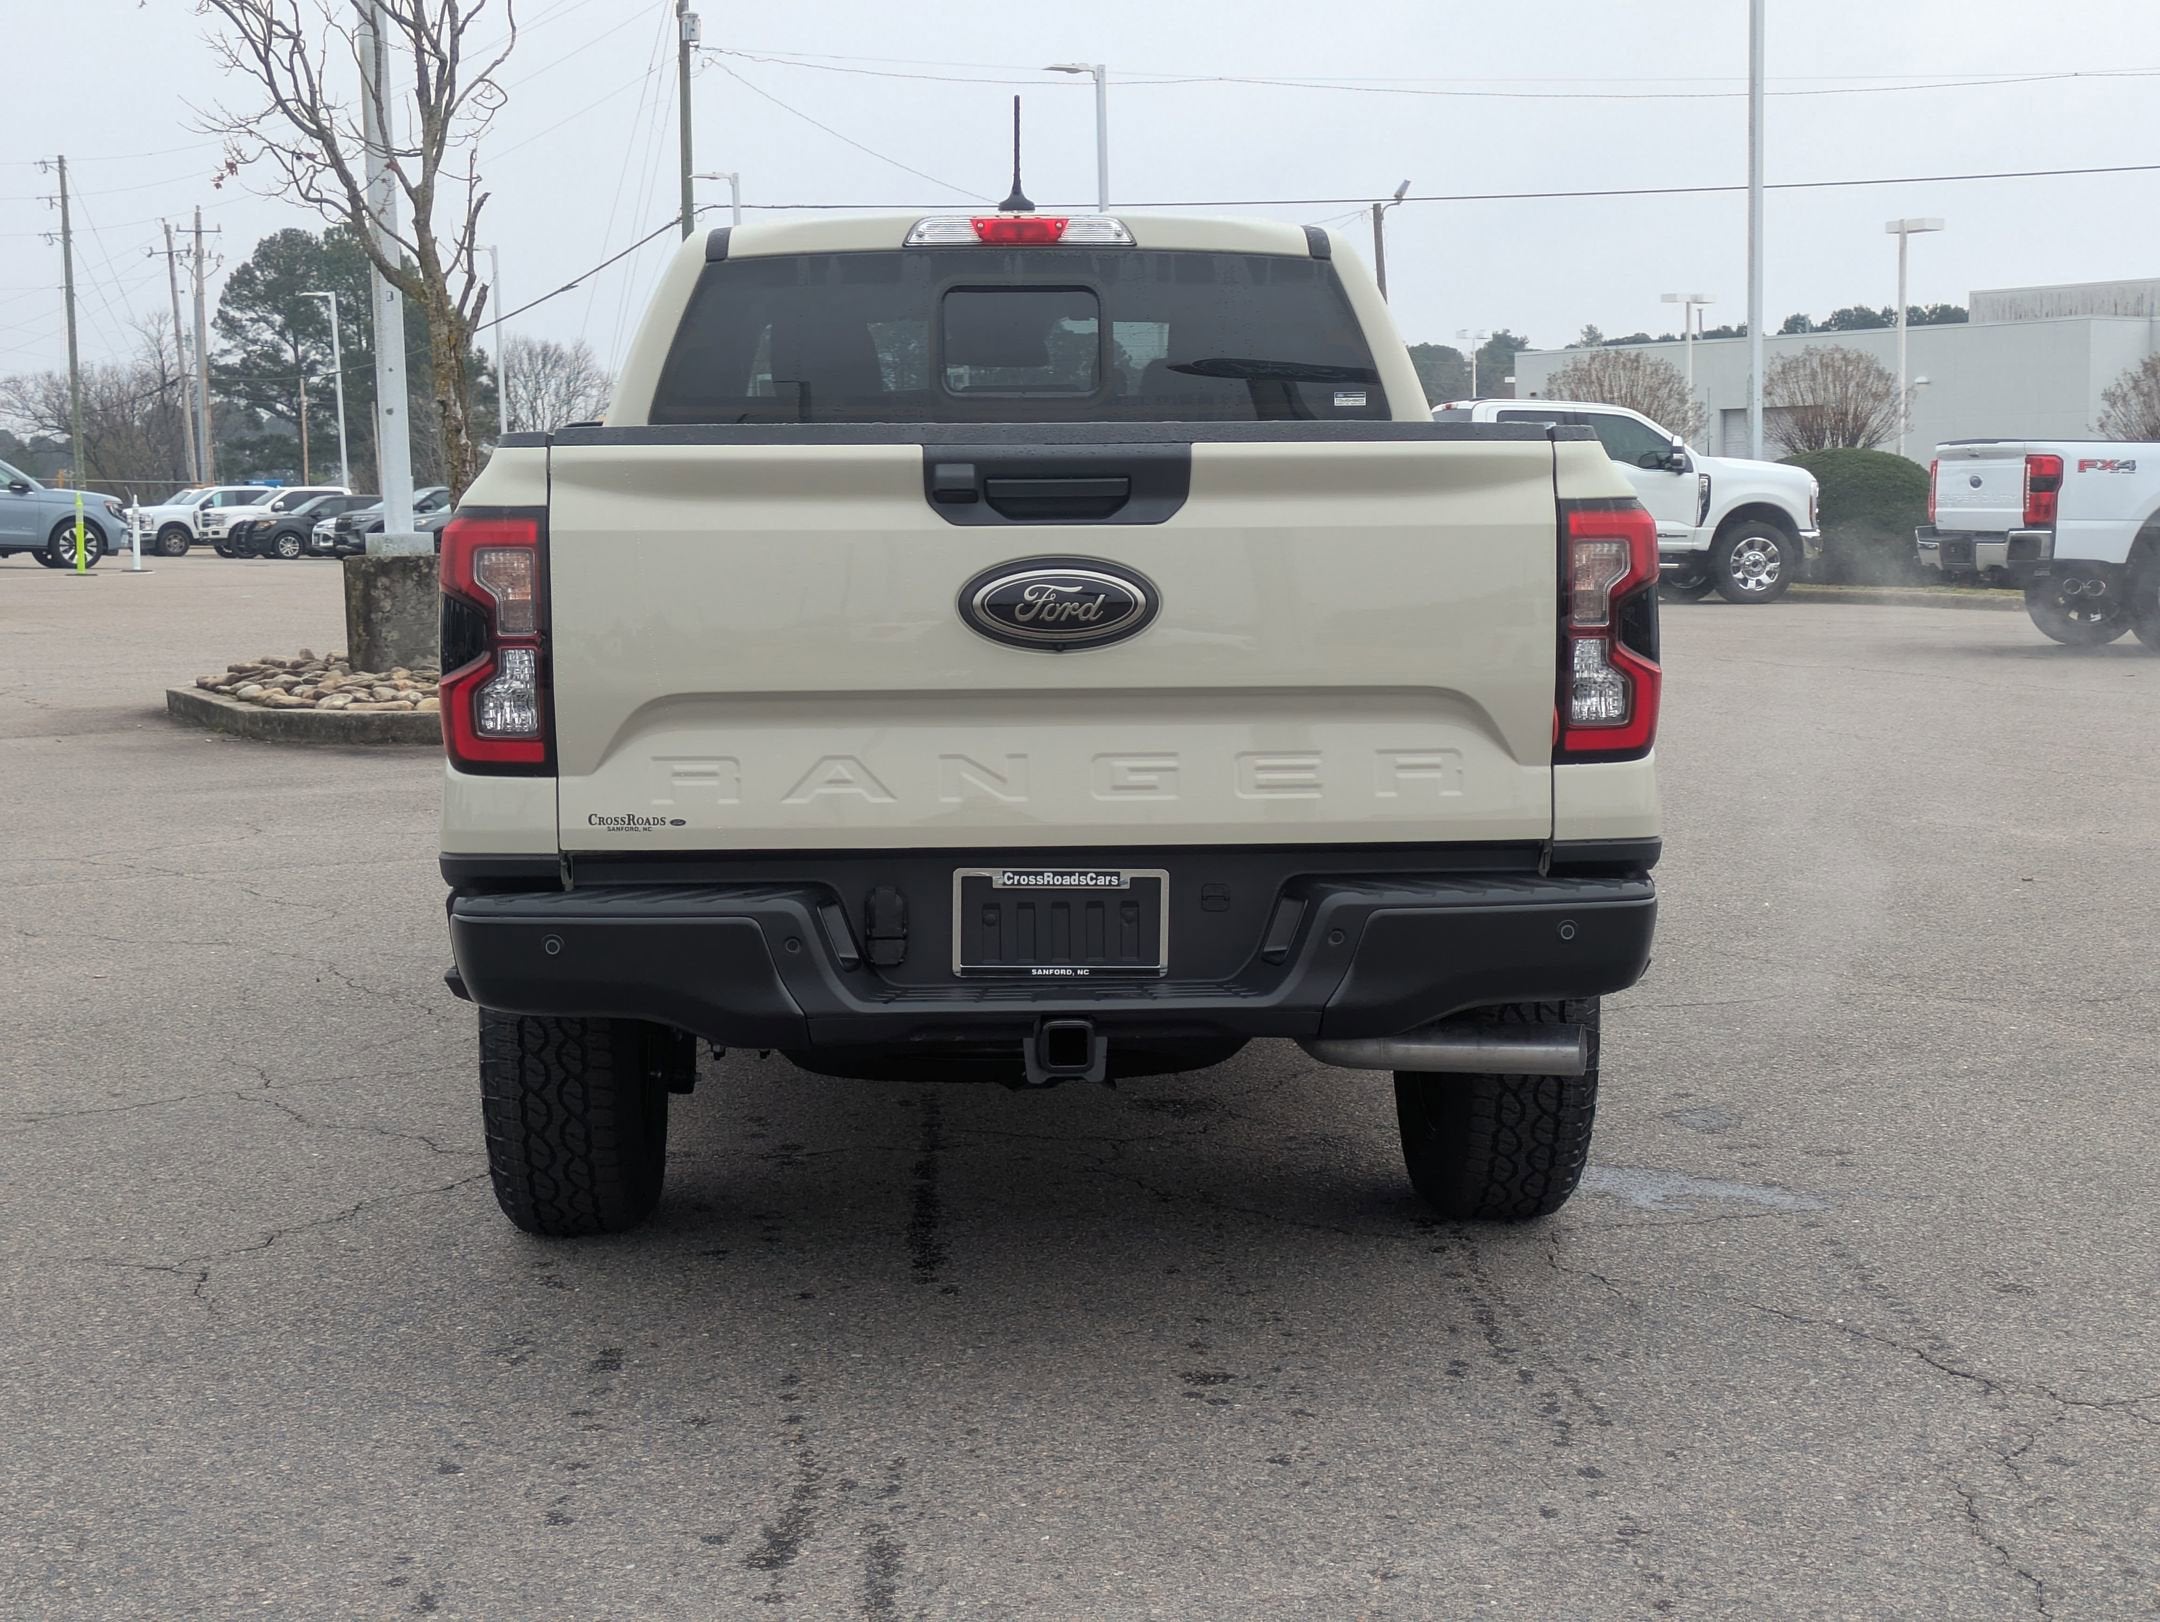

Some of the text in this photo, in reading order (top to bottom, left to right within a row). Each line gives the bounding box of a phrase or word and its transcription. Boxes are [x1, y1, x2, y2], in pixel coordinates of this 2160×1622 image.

[2078, 459, 2136, 472] FX4
[1015, 584, 1106, 622] Ford
[651, 747, 1463, 805] RANGER
[1003, 872, 1119, 886] CrossRoadsCars
[1031, 969, 1075, 977] SANFORD,
